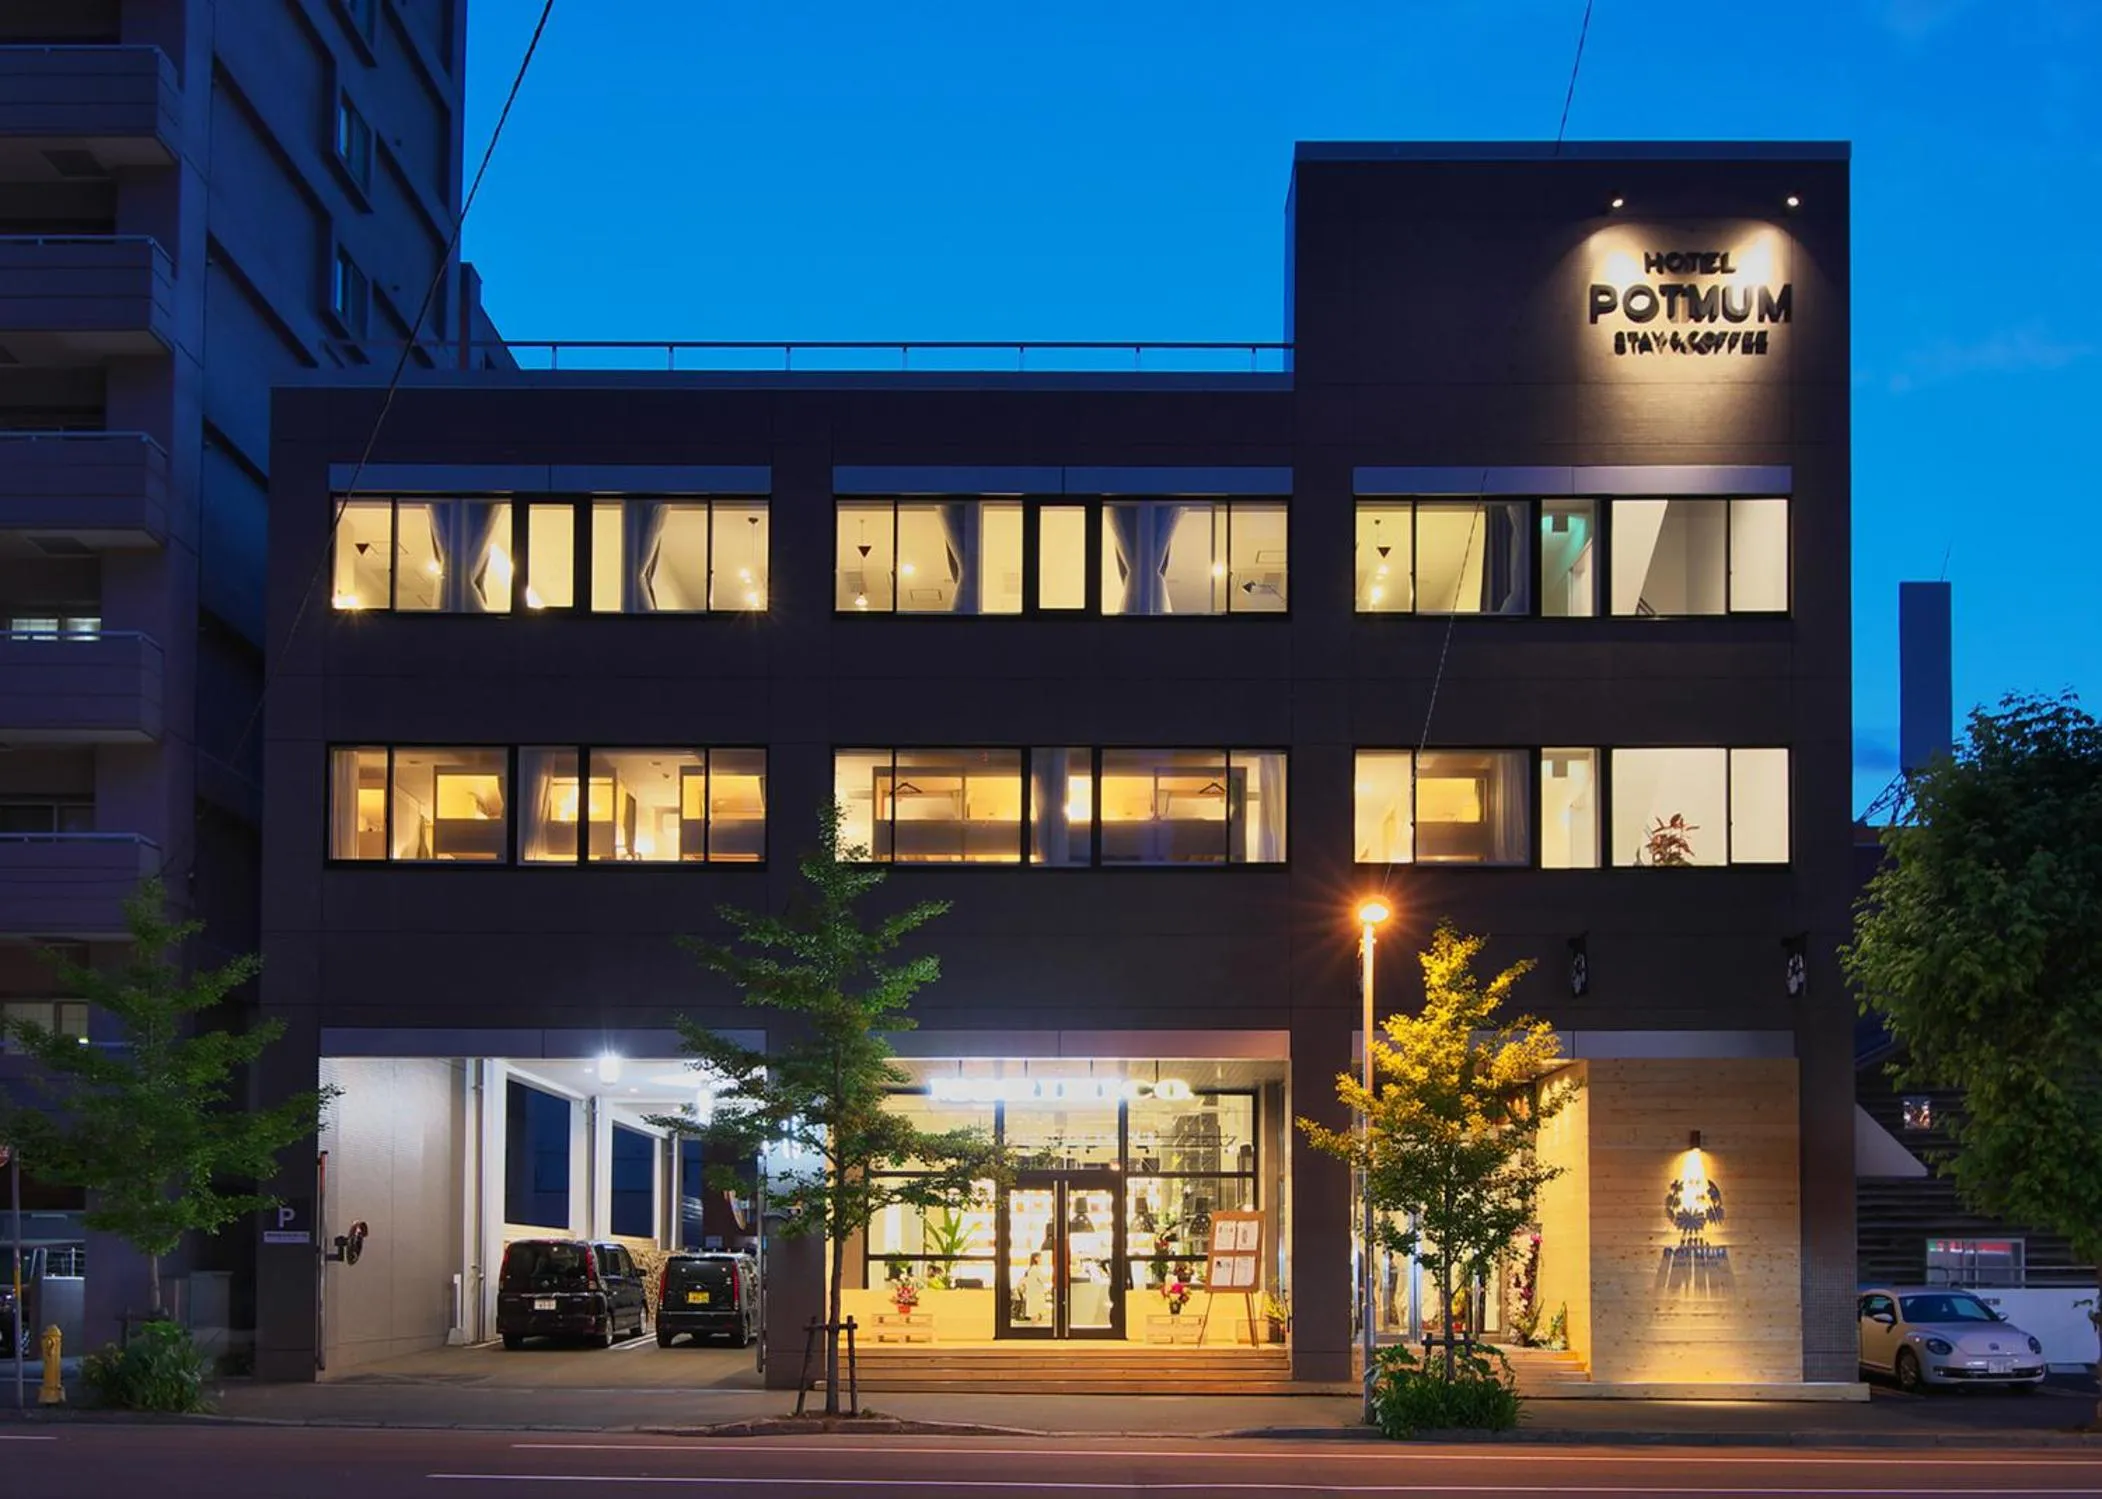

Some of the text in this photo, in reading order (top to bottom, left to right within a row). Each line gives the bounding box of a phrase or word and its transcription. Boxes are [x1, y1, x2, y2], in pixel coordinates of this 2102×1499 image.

[1644, 252, 1736, 274] HOTEL
[1589, 284, 1793, 324] POTMUM
[279, 1207, 295, 1228] P
